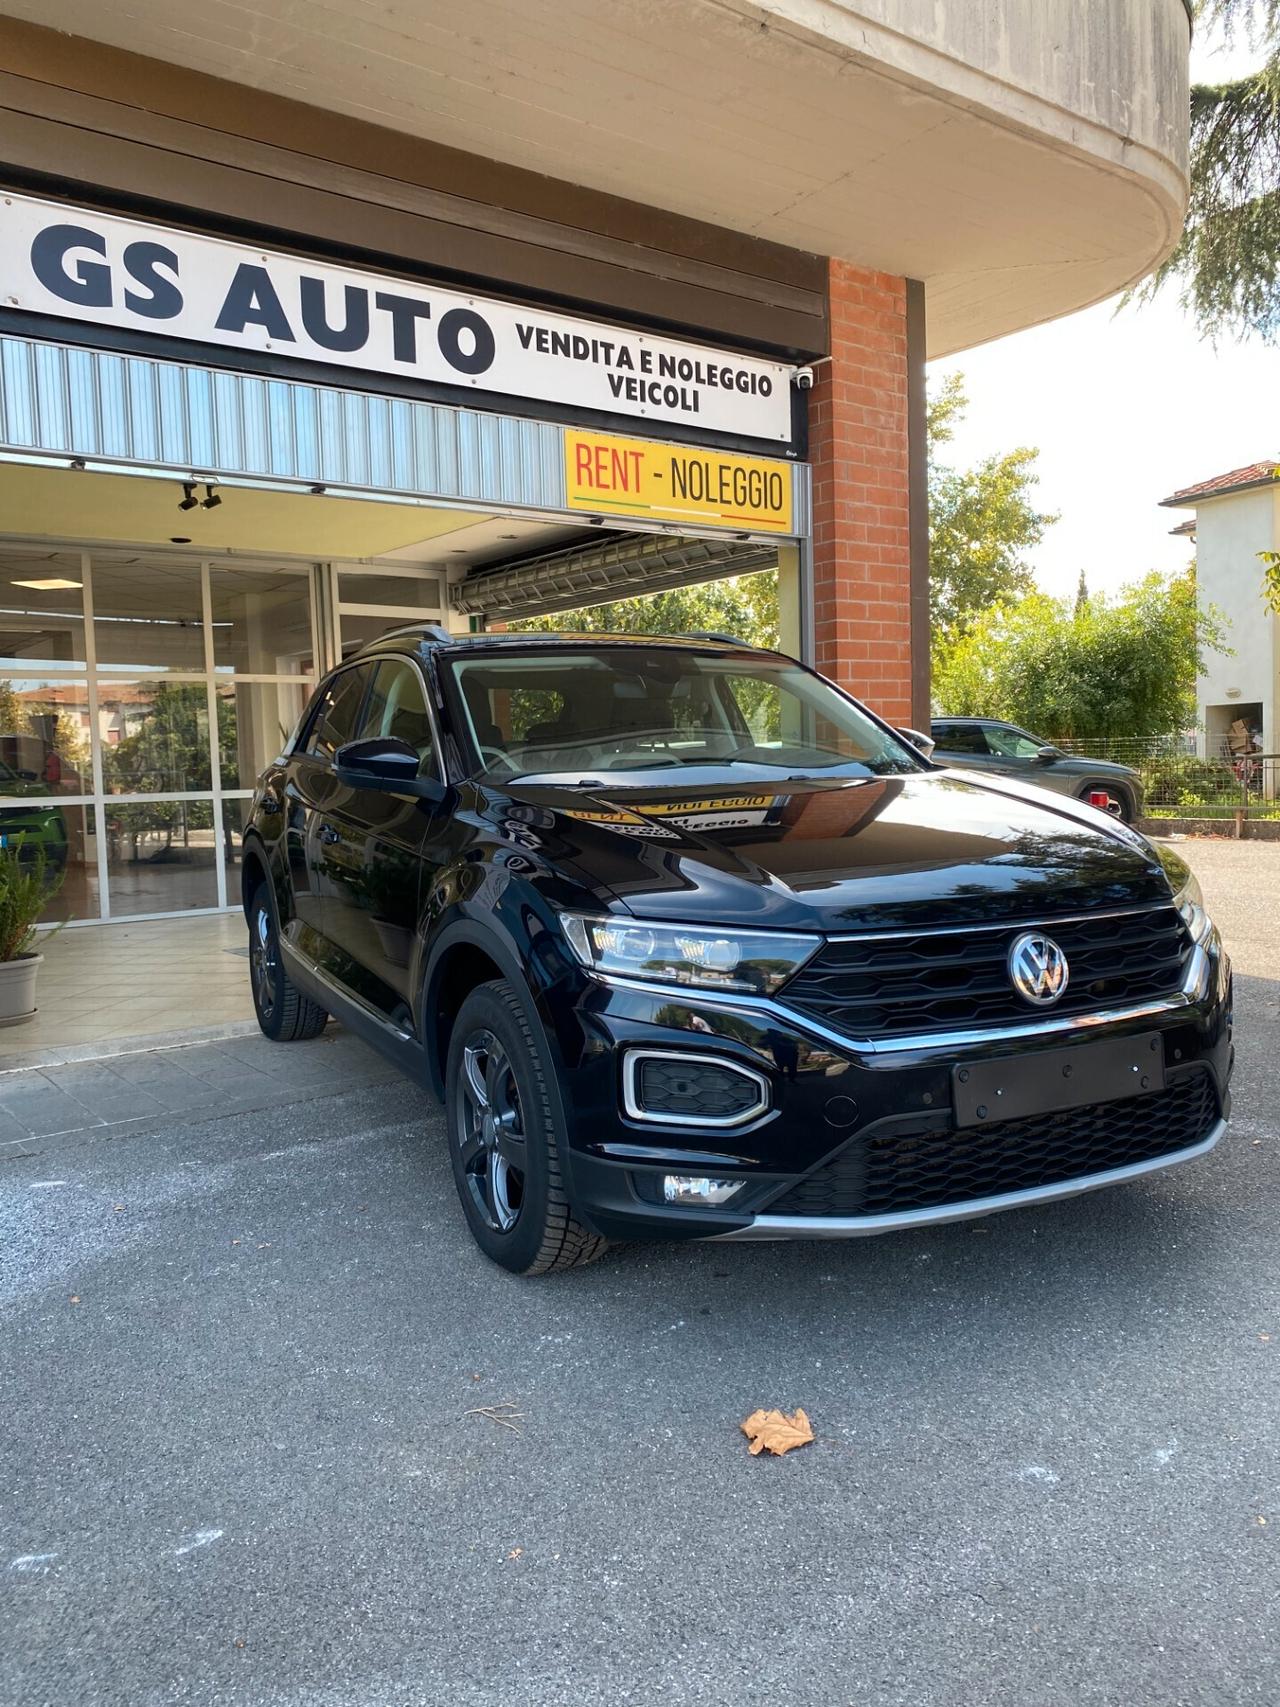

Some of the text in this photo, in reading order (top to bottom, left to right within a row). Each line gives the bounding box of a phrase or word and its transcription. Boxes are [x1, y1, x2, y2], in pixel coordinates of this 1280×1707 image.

[30, 223, 496, 375] GS AUTO
[515, 323, 773, 397] VENDITA E NOLEGGIO
[607, 374, 699, 412] VEICOLI
[576, 443, 644, 493] RENT
[672, 458, 783, 511] NOLEGGIO
